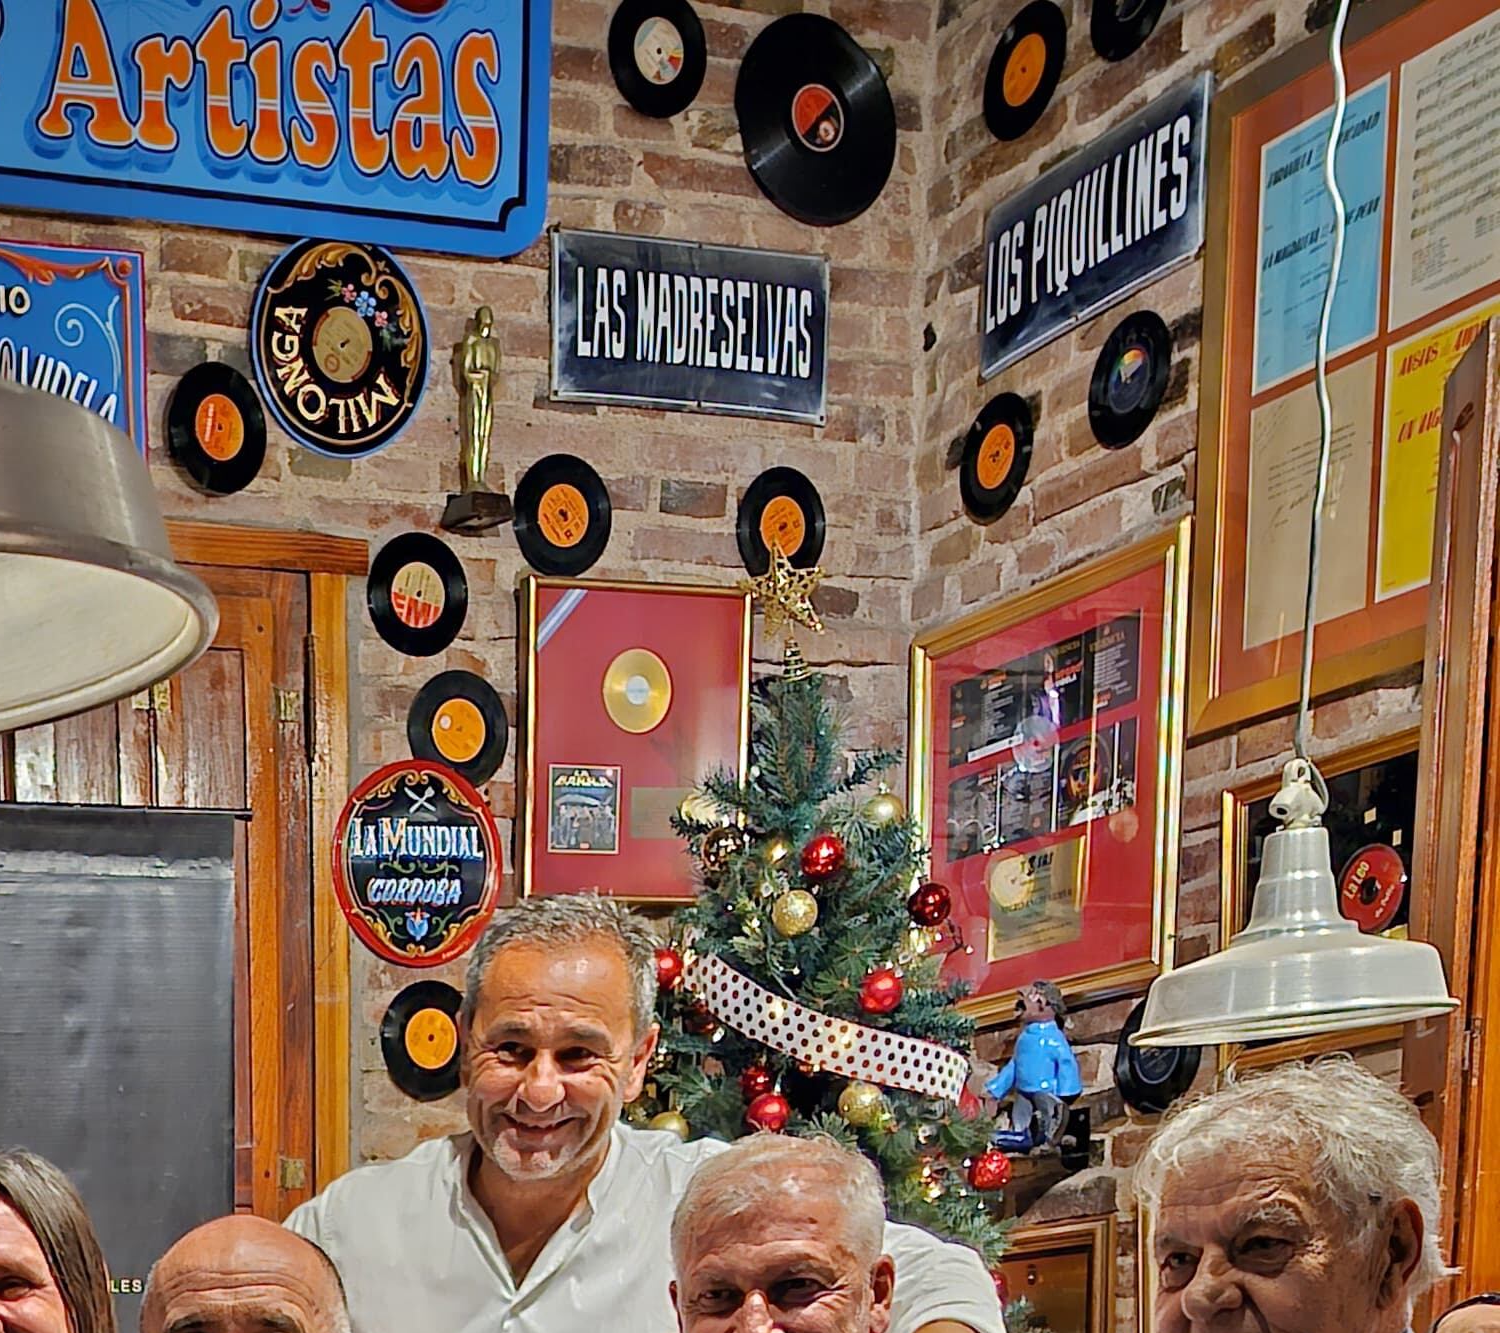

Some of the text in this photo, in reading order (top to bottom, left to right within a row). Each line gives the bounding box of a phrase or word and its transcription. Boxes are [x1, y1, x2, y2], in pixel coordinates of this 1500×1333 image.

[38, 0, 503, 188] Artistas
[984, 219, 1025, 336] LOS
[1030, 113, 1192, 304] PIQUILLINES
[271, 305, 401, 434] MILONGA
[576, 265, 813, 380] LAS MADRESELVAS
[368, 878, 462, 905] CORDOBA
[379, 817, 484, 859] MUNDIAL
